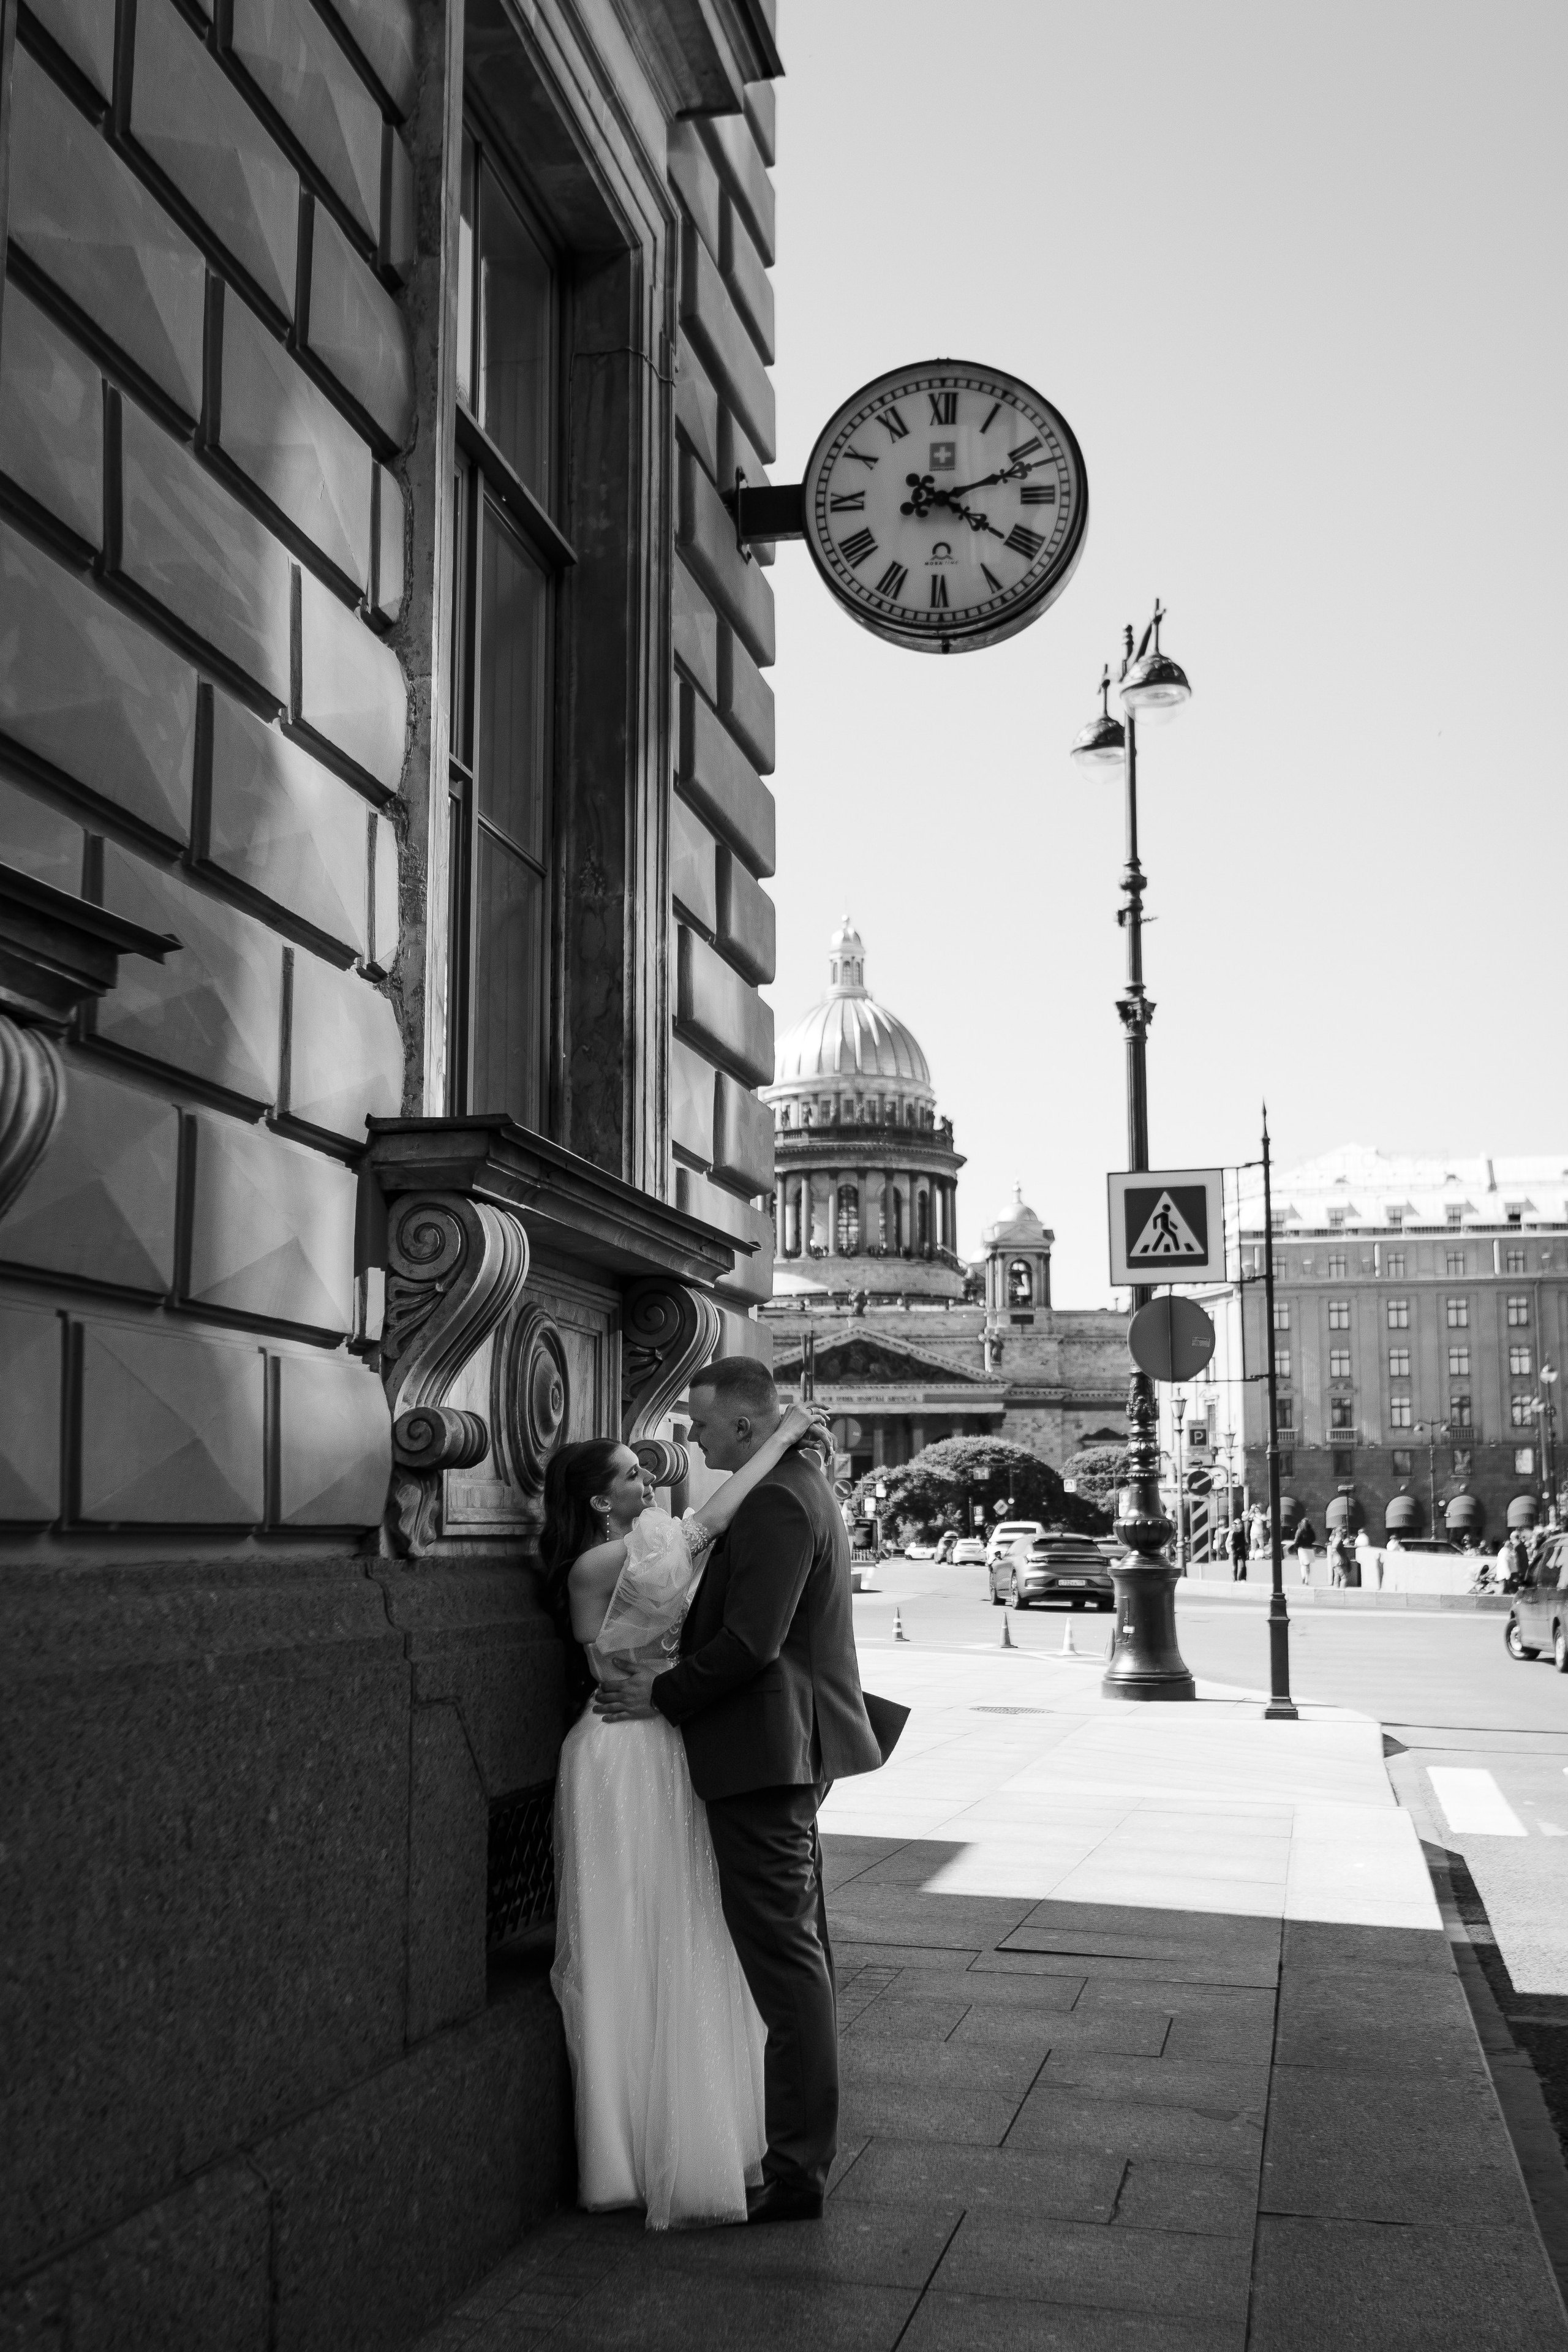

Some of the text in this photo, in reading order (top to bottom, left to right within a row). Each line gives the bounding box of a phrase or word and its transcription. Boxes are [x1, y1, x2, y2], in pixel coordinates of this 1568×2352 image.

[875, 405, 910, 443] XI
[929, 392, 958, 425] XII
[980, 403, 1001, 434] I
[843, 445, 878, 470] X
[1008, 436, 1043, 462] II
[831, 491, 865, 513] IX
[1020, 485, 1055, 505] III
[838, 527, 878, 569] VIII
[1003, 524, 1046, 560] IIII
[875, 561, 909, 601] VII
[930, 575, 949, 608] VI
[980, 562, 1003, 594] V
[1194, 1431, 1204, 1444] P
